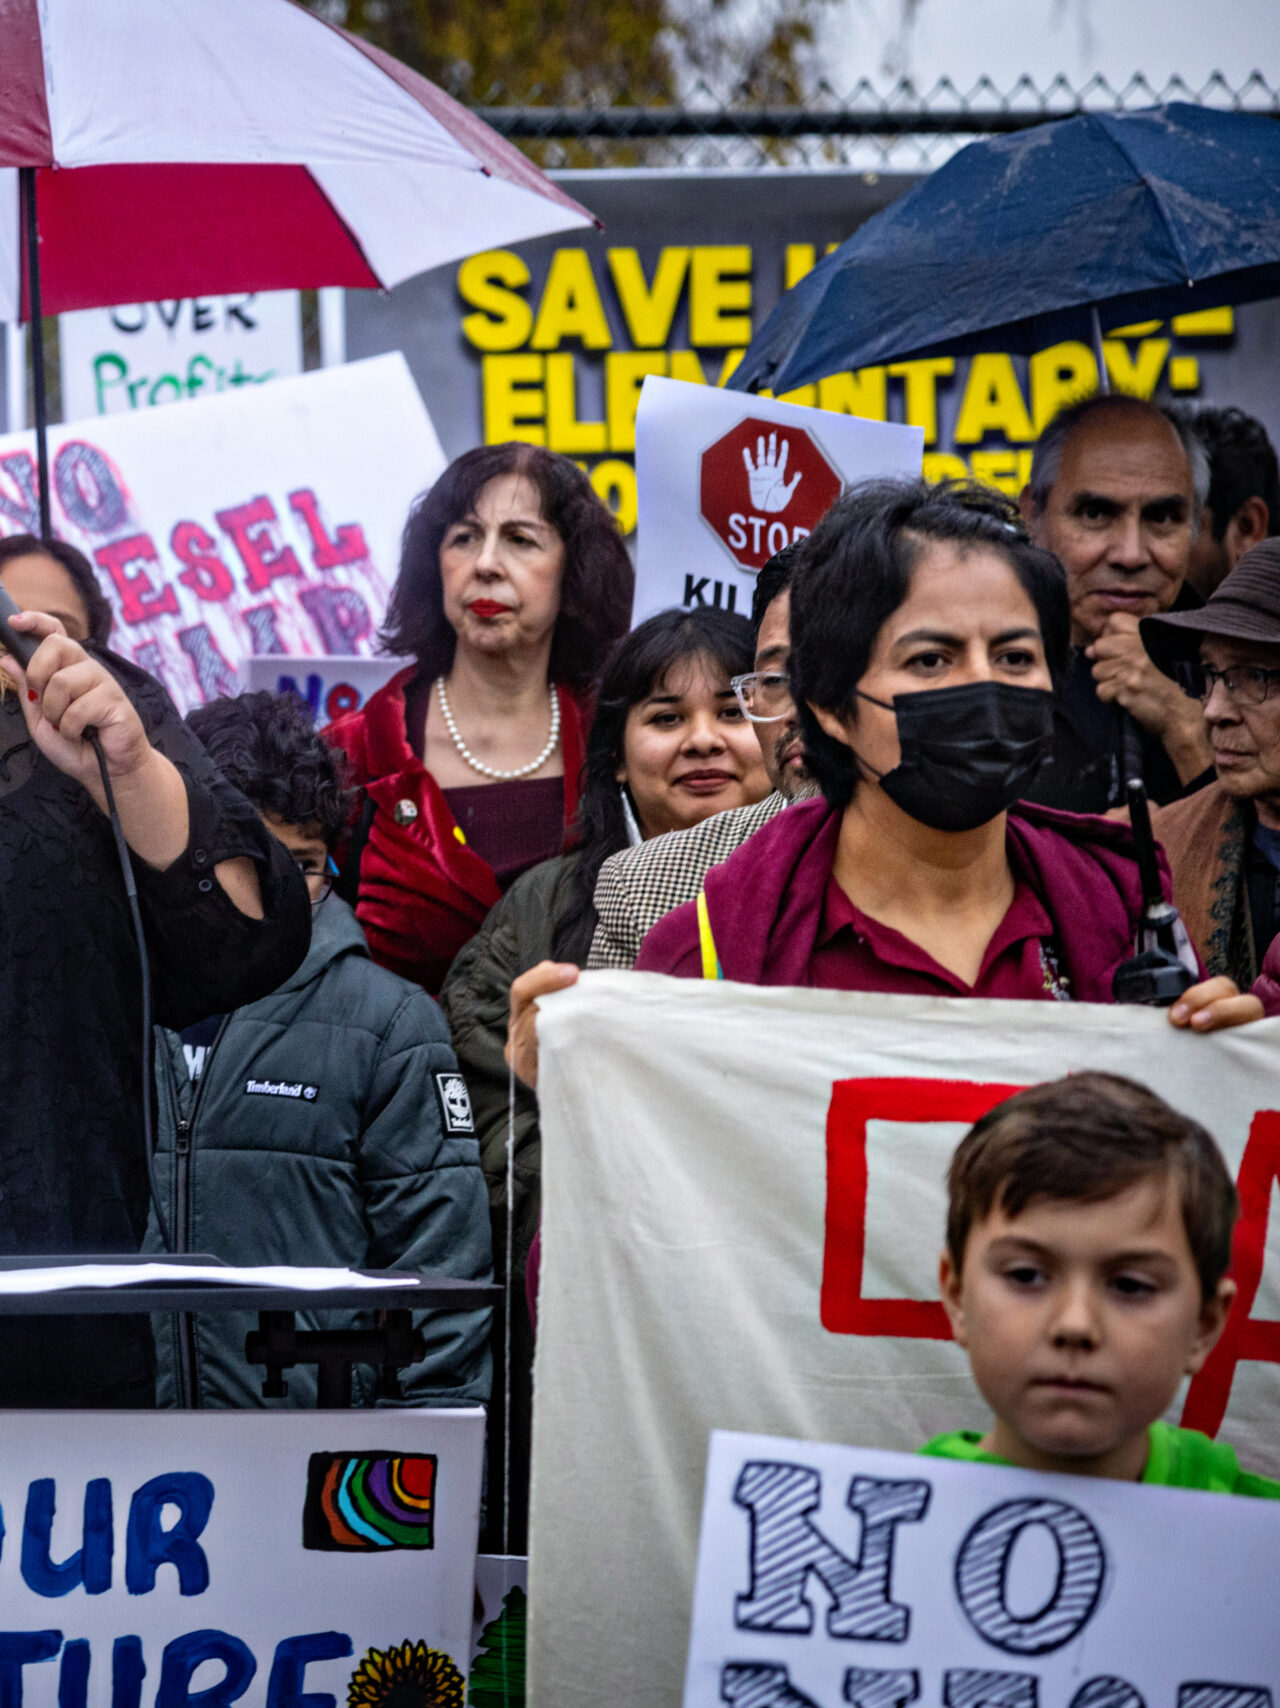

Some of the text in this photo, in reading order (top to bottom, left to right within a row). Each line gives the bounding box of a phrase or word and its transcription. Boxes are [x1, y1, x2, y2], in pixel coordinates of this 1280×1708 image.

[457, 245, 752, 352] SAVE
[92, 352, 277, 415] Profit
[95, 487, 371, 626] ESEL
[732, 1458, 1106, 1657] NO
